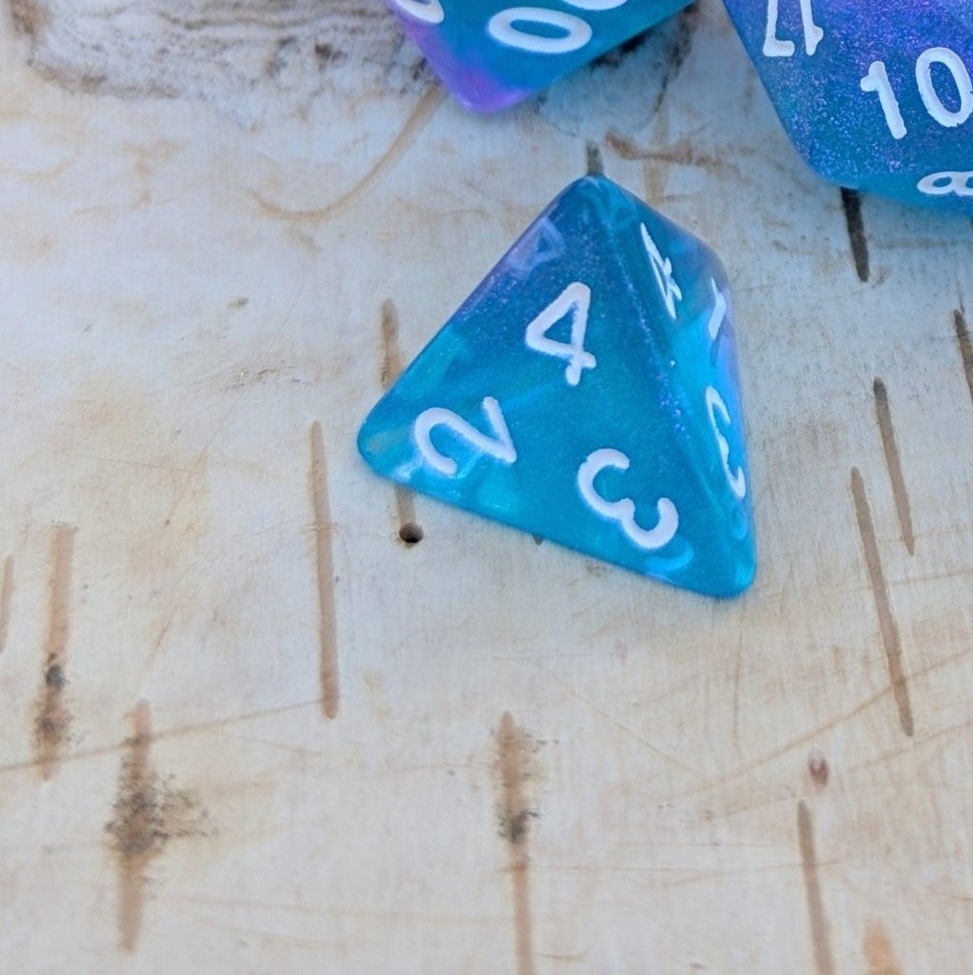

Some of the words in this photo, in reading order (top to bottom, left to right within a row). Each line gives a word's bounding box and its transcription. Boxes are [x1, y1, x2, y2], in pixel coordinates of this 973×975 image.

[861, 47, 973, 139] 10
[640, 222, 682, 319] 4
[525, 282, 597, 386] 4
[414, 396, 517, 475] 2
[706, 386, 746, 498] 3
[578, 448, 678, 549] 3
